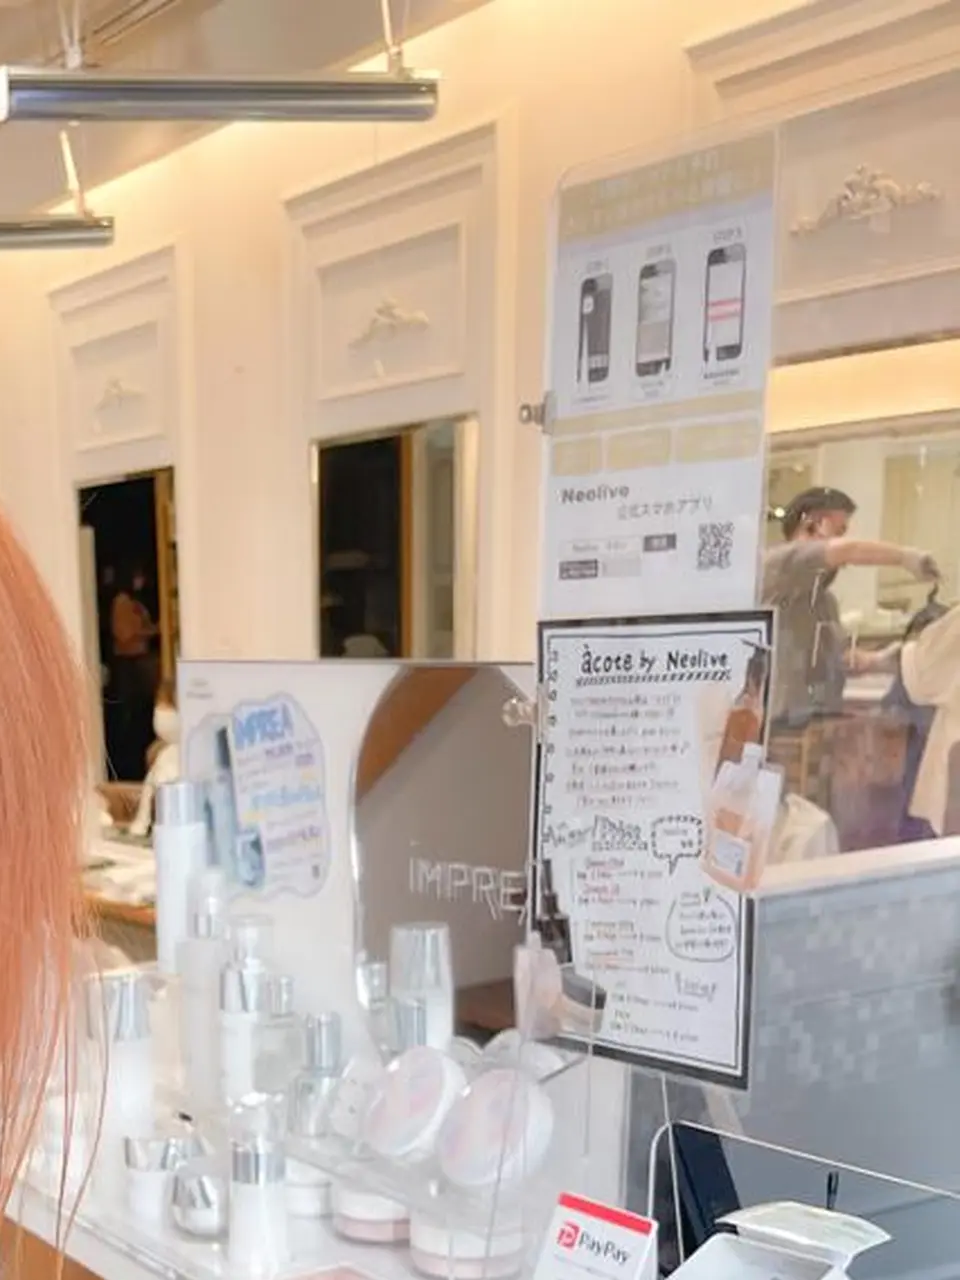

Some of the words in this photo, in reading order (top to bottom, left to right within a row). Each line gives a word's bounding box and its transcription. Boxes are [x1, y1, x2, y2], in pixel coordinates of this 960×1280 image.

[640, 650, 656, 672] by
[667, 648, 728, 671] Neolive
[579, 1230, 632, 1266] PayPay
